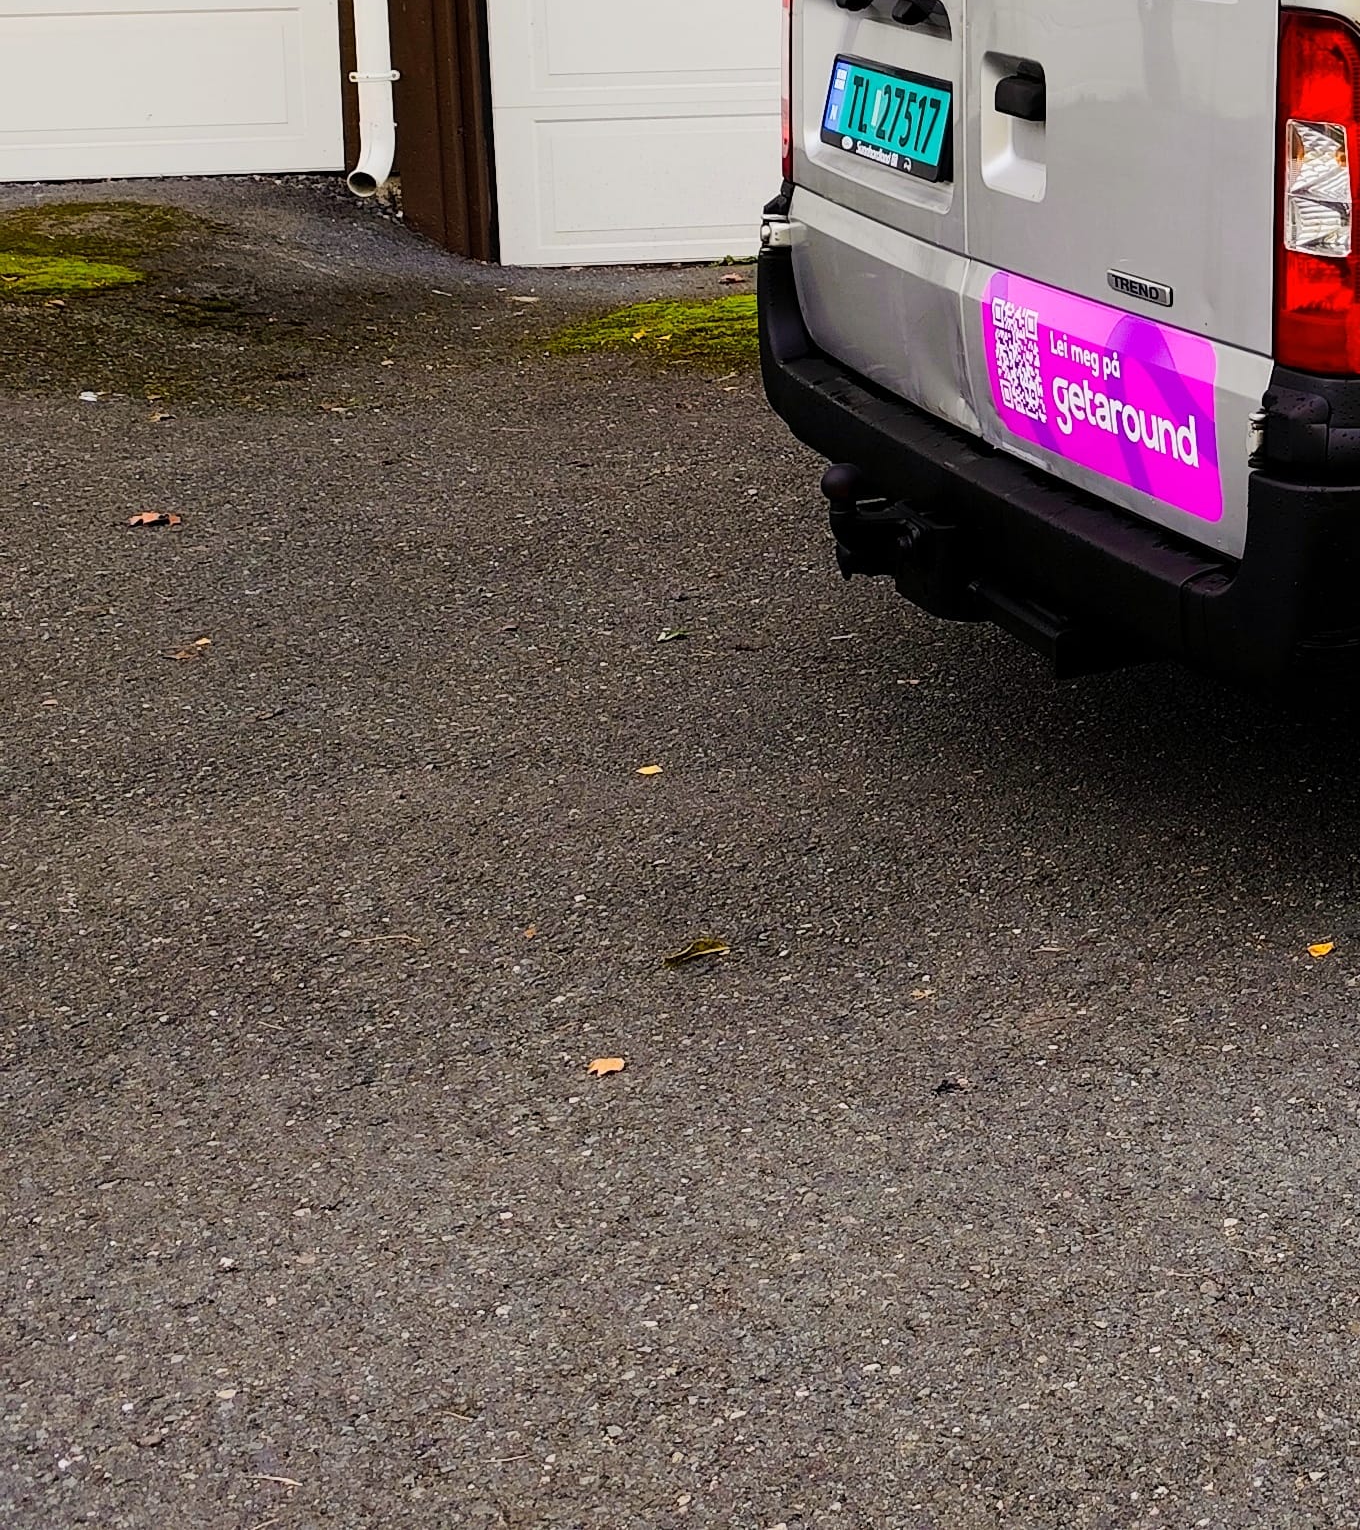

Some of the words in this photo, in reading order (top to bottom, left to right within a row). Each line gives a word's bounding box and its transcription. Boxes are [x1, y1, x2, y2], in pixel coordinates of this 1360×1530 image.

[848, 75, 870, 134] TL
[875, 84, 942, 154] 27517
[1112, 273, 1159, 301] TREND
[1050, 331, 1068, 358] Lei
[1071, 344, 1099, 377] meg
[1103, 352, 1120, 381] på
[1052, 376, 1199, 468] getaround
